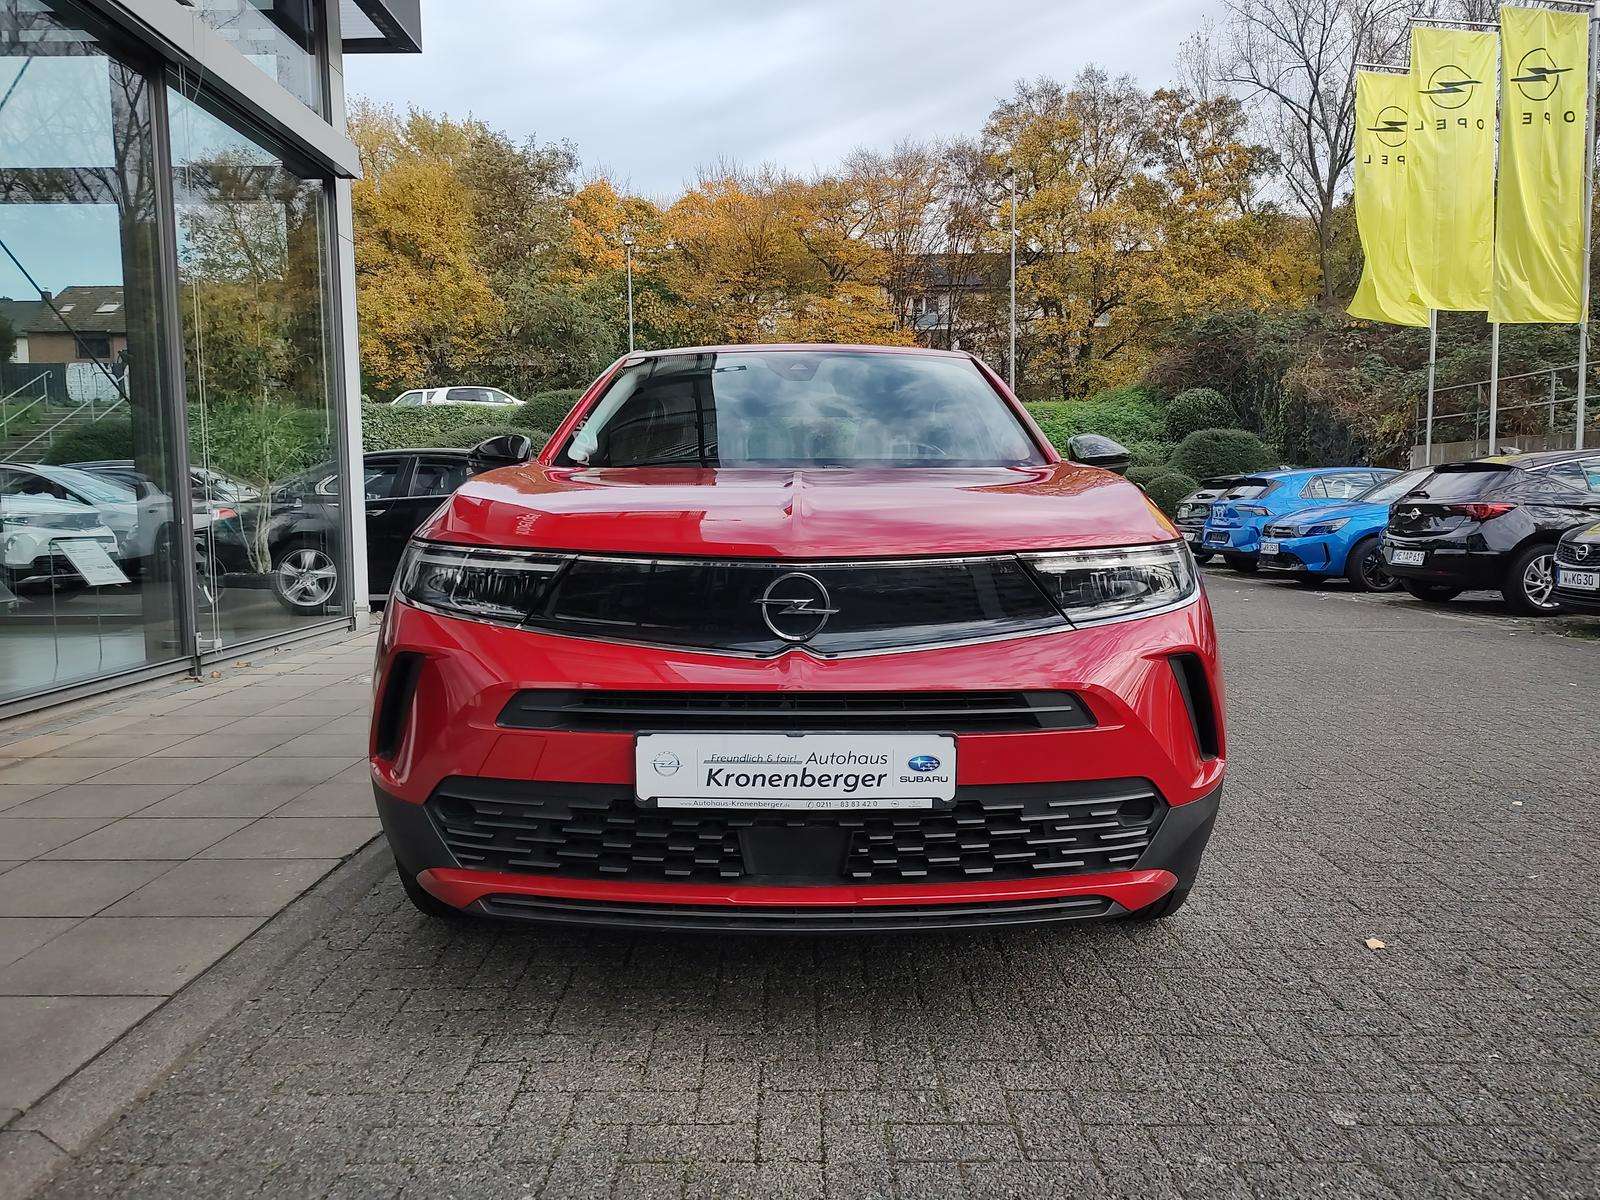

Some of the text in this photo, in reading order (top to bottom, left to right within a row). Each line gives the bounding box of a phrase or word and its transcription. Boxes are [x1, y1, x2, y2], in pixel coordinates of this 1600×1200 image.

[1571, 573, 1582, 585] KG
[1583, 574, 1594, 586] 30
[711, 753, 797, 764] Freundlich & fair!
[805, 751, 888, 765] Autohaus
[706, 767, 888, 793] Kronenberger
[899, 775, 949, 783] SUBARU
